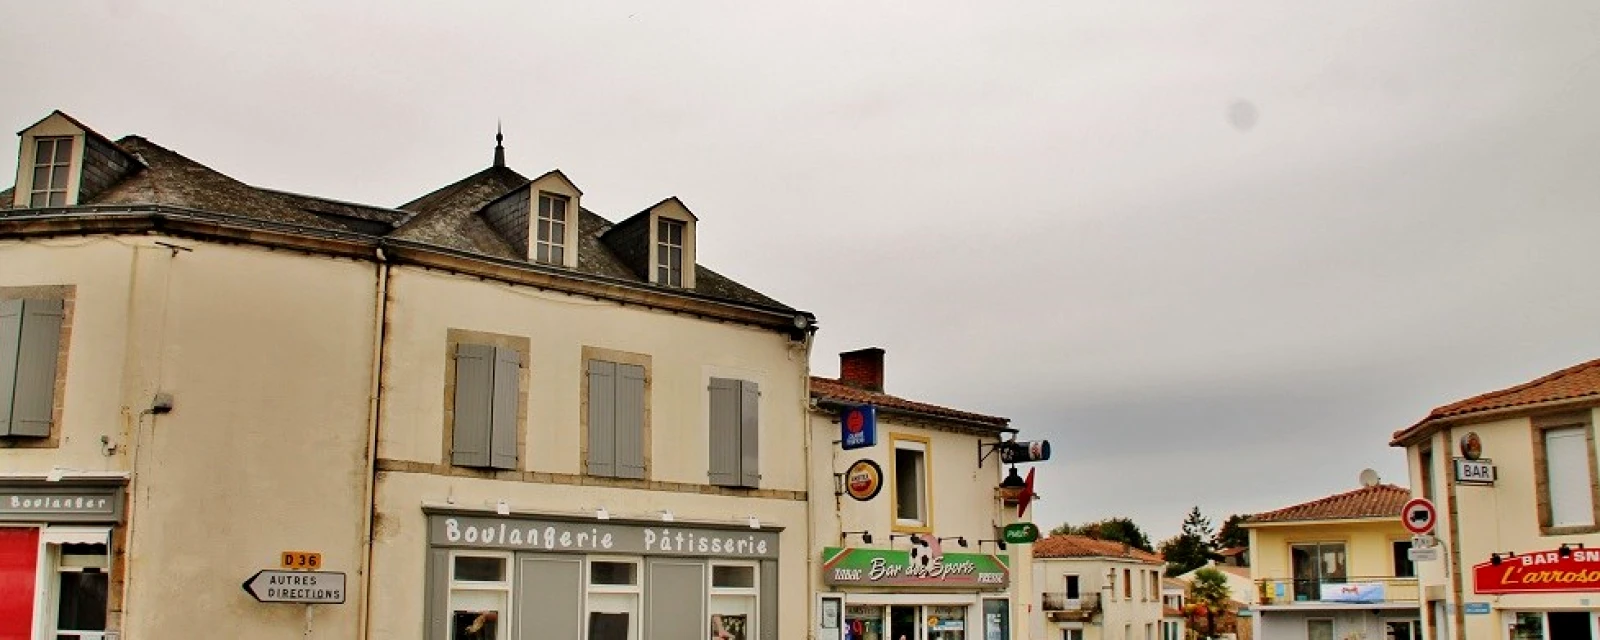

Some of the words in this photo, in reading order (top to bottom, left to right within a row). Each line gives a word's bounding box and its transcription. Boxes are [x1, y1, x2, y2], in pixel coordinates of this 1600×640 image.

[1463, 464, 1490, 478] BAR
[445, 518, 614, 550] Boulangerie
[644, 528, 768, 555] Pâtisserie
[285, 554, 294, 565] D
[298, 555, 317, 566] 36
[1522, 552, 1560, 566] BAR
[868, 557, 903, 580] Bar
[928, 556, 976, 581] Sports
[270, 575, 317, 585] AUTRES
[268, 588, 340, 600] DIRECTIONS
